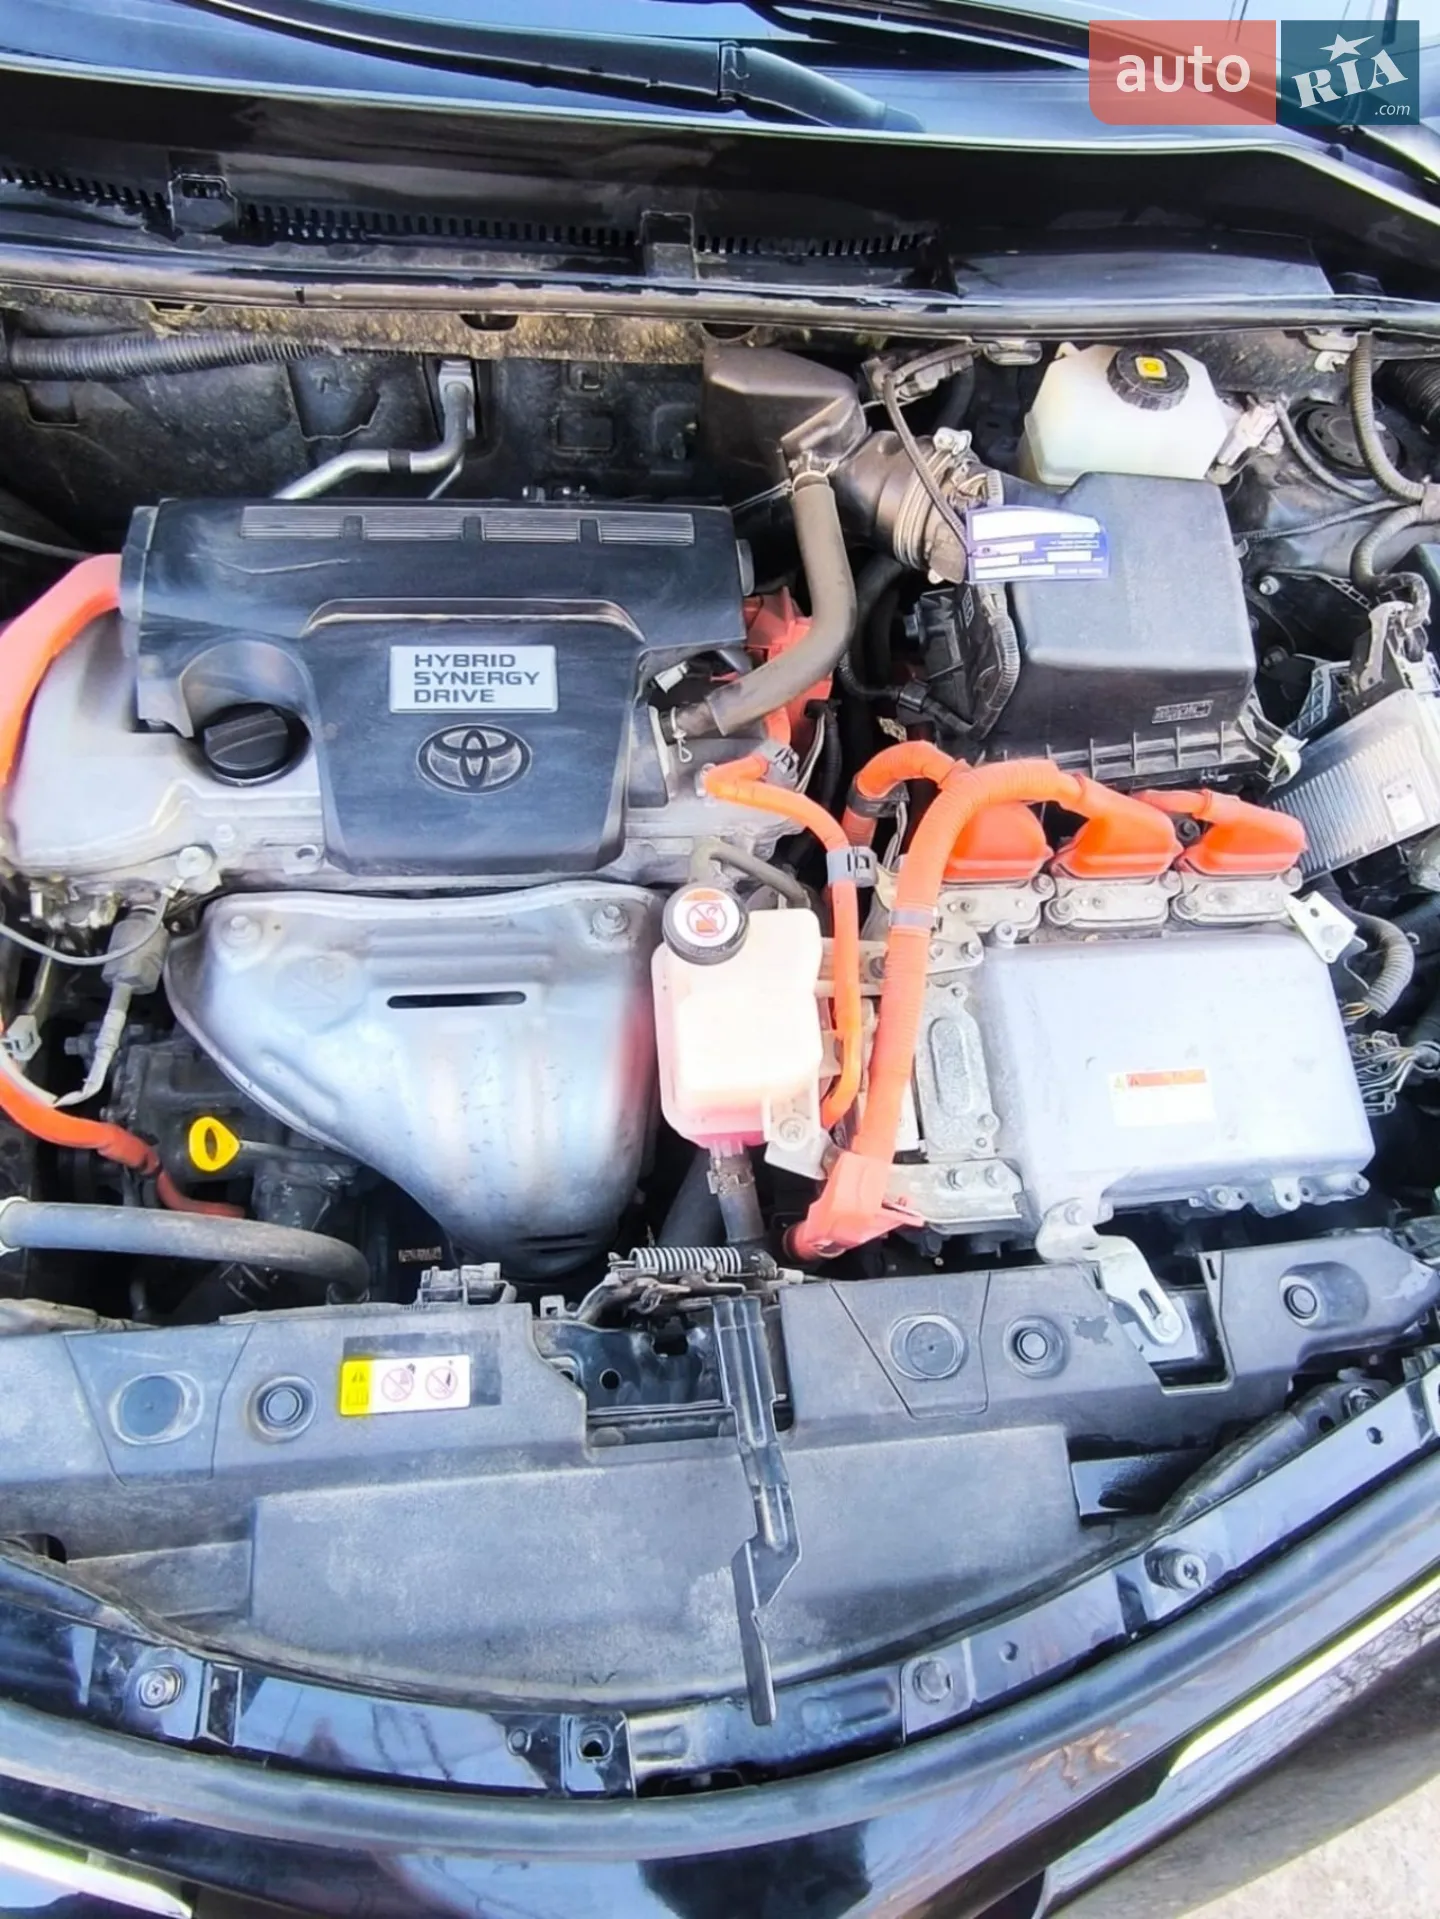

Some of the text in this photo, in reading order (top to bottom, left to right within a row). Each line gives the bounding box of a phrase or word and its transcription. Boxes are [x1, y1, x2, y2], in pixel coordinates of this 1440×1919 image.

[414, 654, 516, 667] HYBRID
[414, 671, 540, 685] SYNERGY
[414, 689, 495, 703] DRIVE
